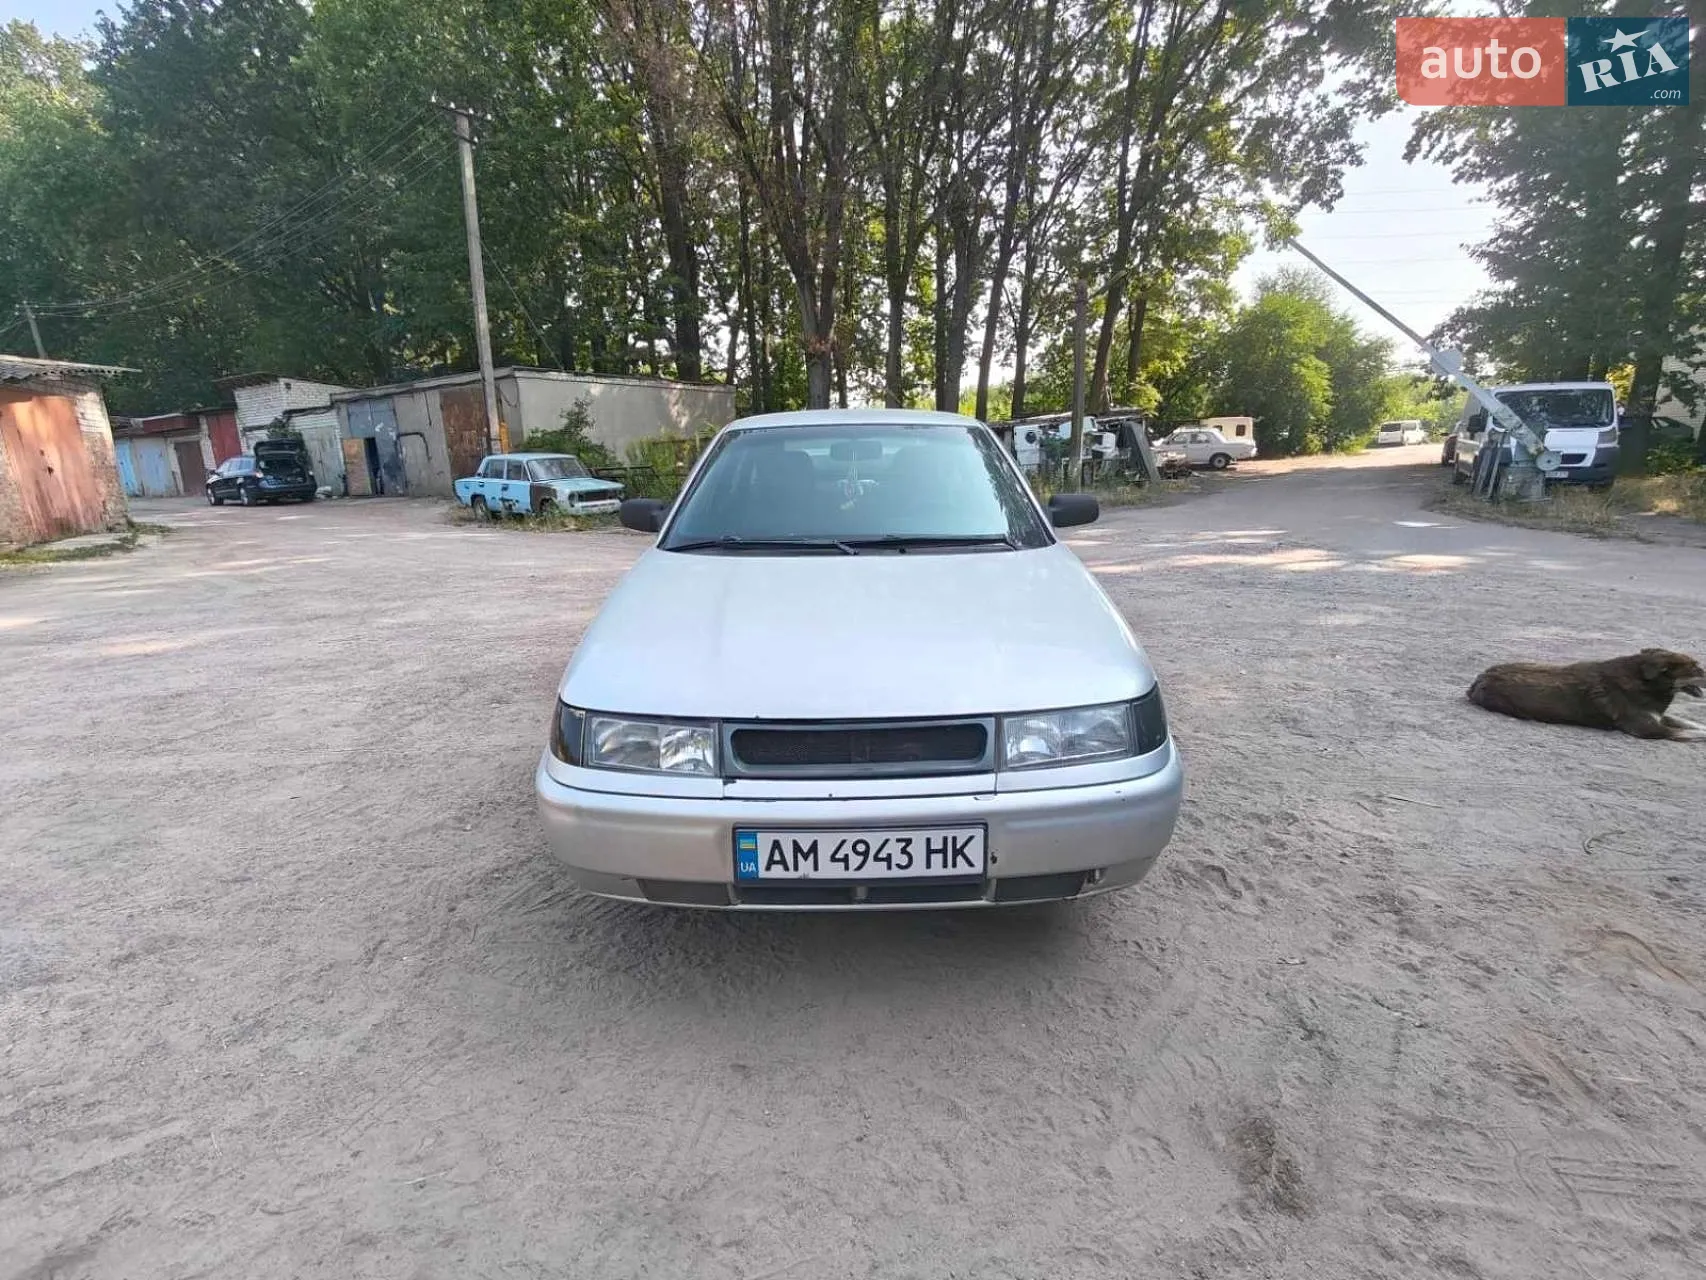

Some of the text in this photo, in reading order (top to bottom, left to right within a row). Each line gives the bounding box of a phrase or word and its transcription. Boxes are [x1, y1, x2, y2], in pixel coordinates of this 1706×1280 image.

[764, 835, 976, 872] AM 4943 HK
[740, 862, 757, 872] UA
